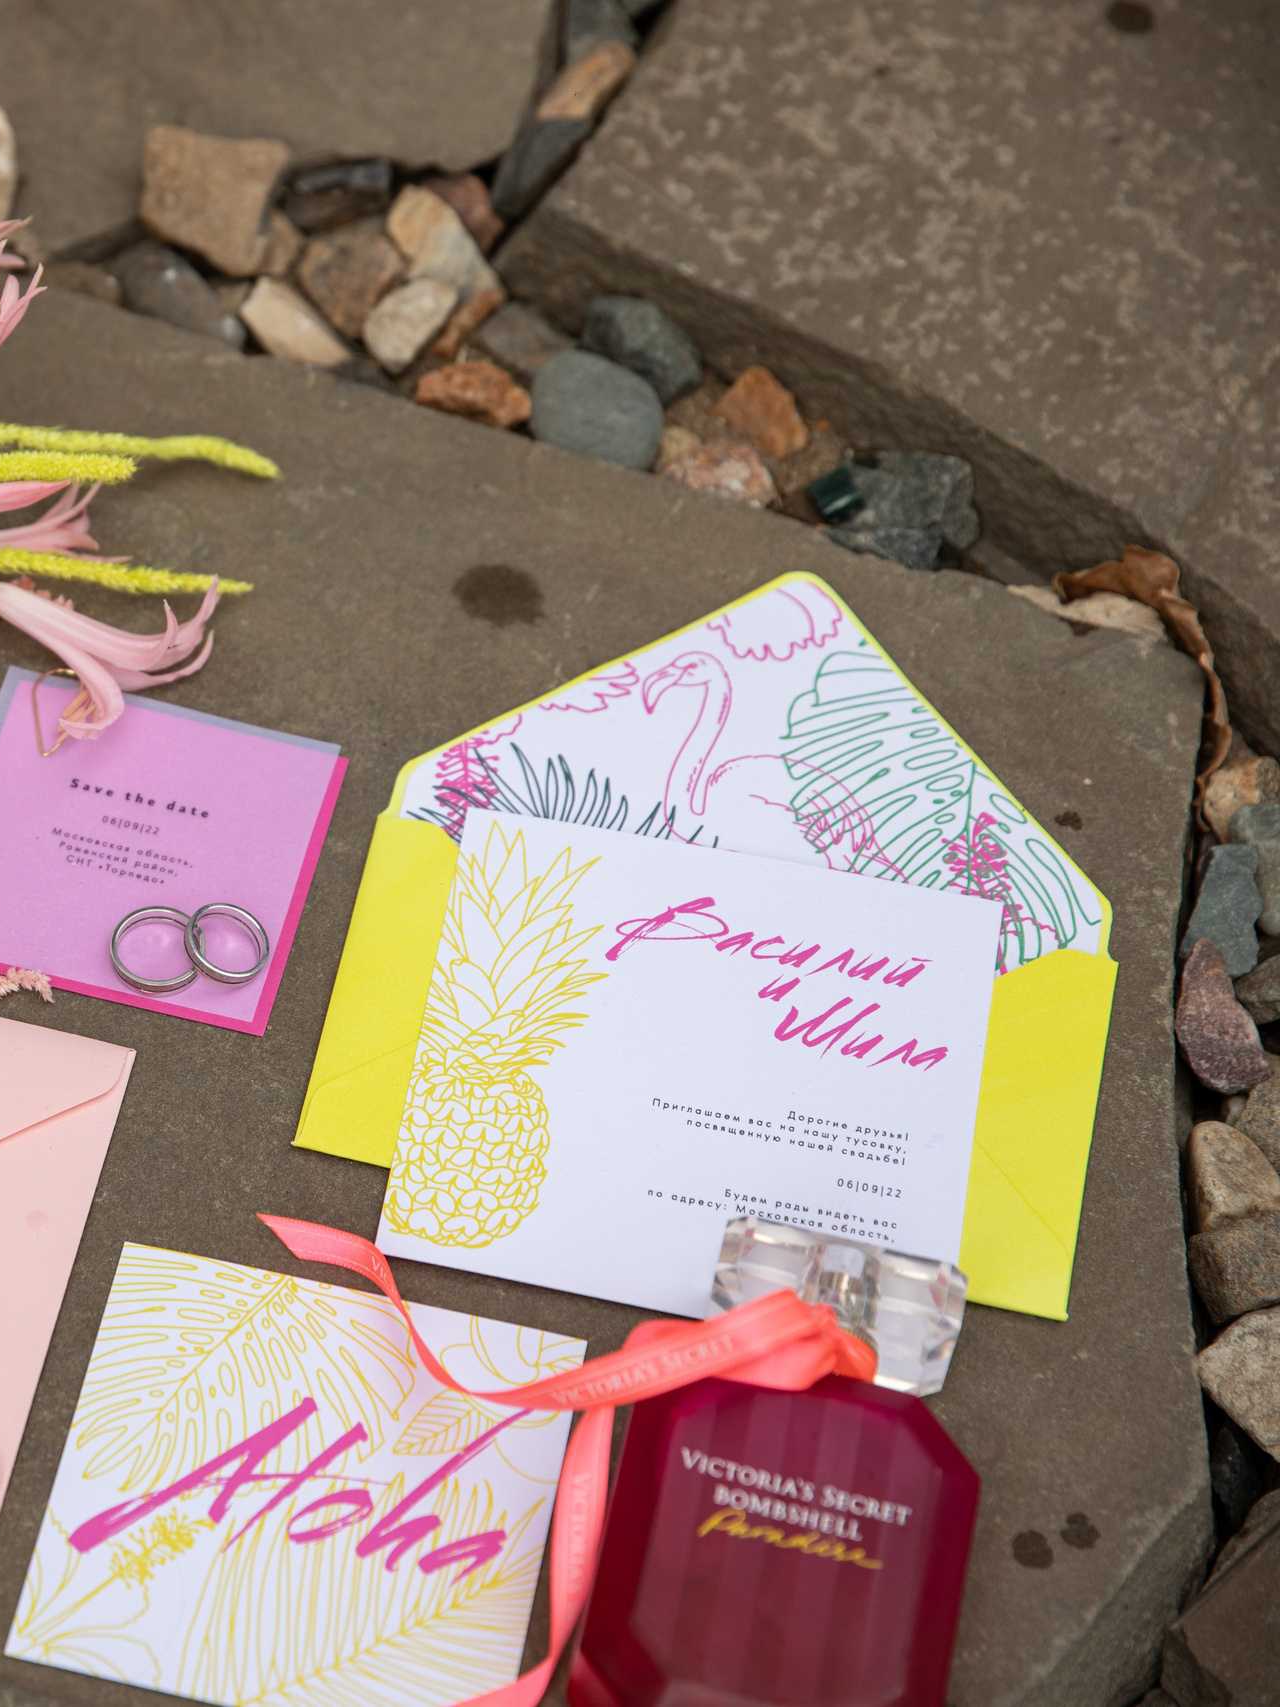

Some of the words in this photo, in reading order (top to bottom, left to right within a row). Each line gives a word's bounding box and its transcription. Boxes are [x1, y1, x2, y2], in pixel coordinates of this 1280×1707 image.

[70, 778, 114, 797] Save
[125, 791, 156, 807] the
[166, 801, 209, 818] date
[51, 827, 130, 853] Московская
[137, 849, 194, 869] область,
[59, 840, 128, 864] Раменский
[134, 859, 178, 877] район,
[66, 854, 93, 868] СНТ
[605, 896, 933, 988] Василий
[652, 1097, 741, 1122] Приглашаем
[748, 1118, 772, 1128] вас
[780, 1124, 795, 1132] на
[803, 1128, 839, 1141] нашу
[846, 1136, 906, 1155] тусовку,
[686, 1119, 781, 1143] посвященную
[789, 1139, 833, 1152] нашей
[841, 1148, 906, 1166] свадьбе!
[787, 1110, 848, 1130] Дорогие
[855, 1125, 909, 1141] друзья!
[724, 1188, 767, 1205] Будем
[775, 1200, 809, 1213] рады
[818, 1208, 865, 1223] видеть
[873, 1219, 898, 1230] вас
[837, 1178, 902, 1198] 06|09|22
[647, 1189, 663, 1198] по
[671, 1194, 727, 1211] адресу:
[736, 1204, 823, 1228] Московская
[831, 1224, 894, 1243] область,
[68, 1397, 535, 1587] Aloha
[681, 1446, 815, 1502] VICTORIA'S
[822, 1484, 913, 1526] SECRET
[713, 1483, 863, 1541] BOMBSHELL
